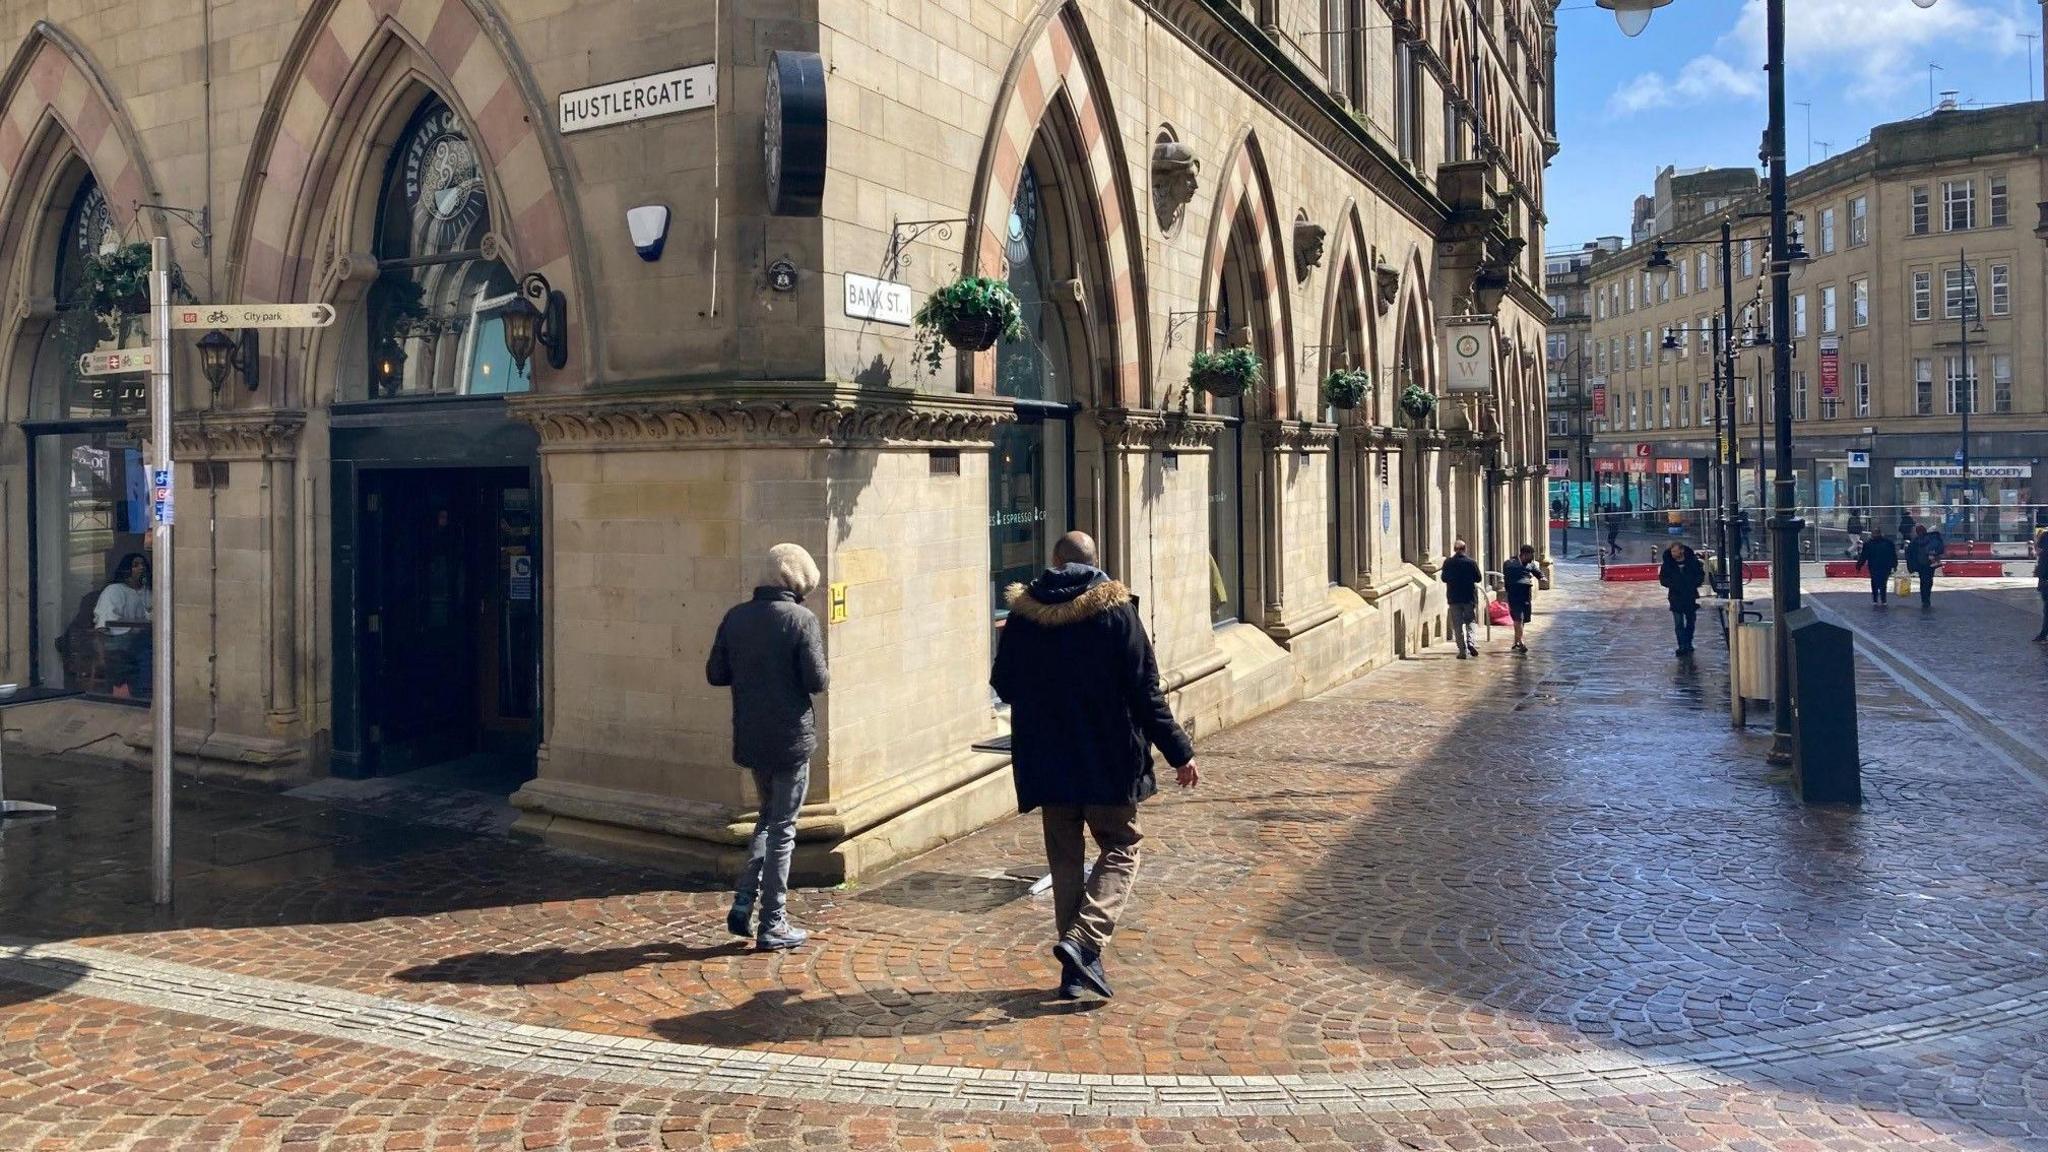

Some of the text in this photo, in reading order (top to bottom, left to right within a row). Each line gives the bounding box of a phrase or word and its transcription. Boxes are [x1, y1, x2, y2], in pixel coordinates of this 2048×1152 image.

[564, 78, 694, 123] HUSTLERGATE
[849, 284, 883, 310] BANK
[887, 291, 903, 313] ST.
[243, 311, 261, 323] City
[262, 311, 282, 322] park
[1456, 361, 1480, 378] W
[1900, 468, 2024, 477] SKIPTON BUILDNG SOCIETY
[1002, 509, 1032, 526] ESPRESSO
